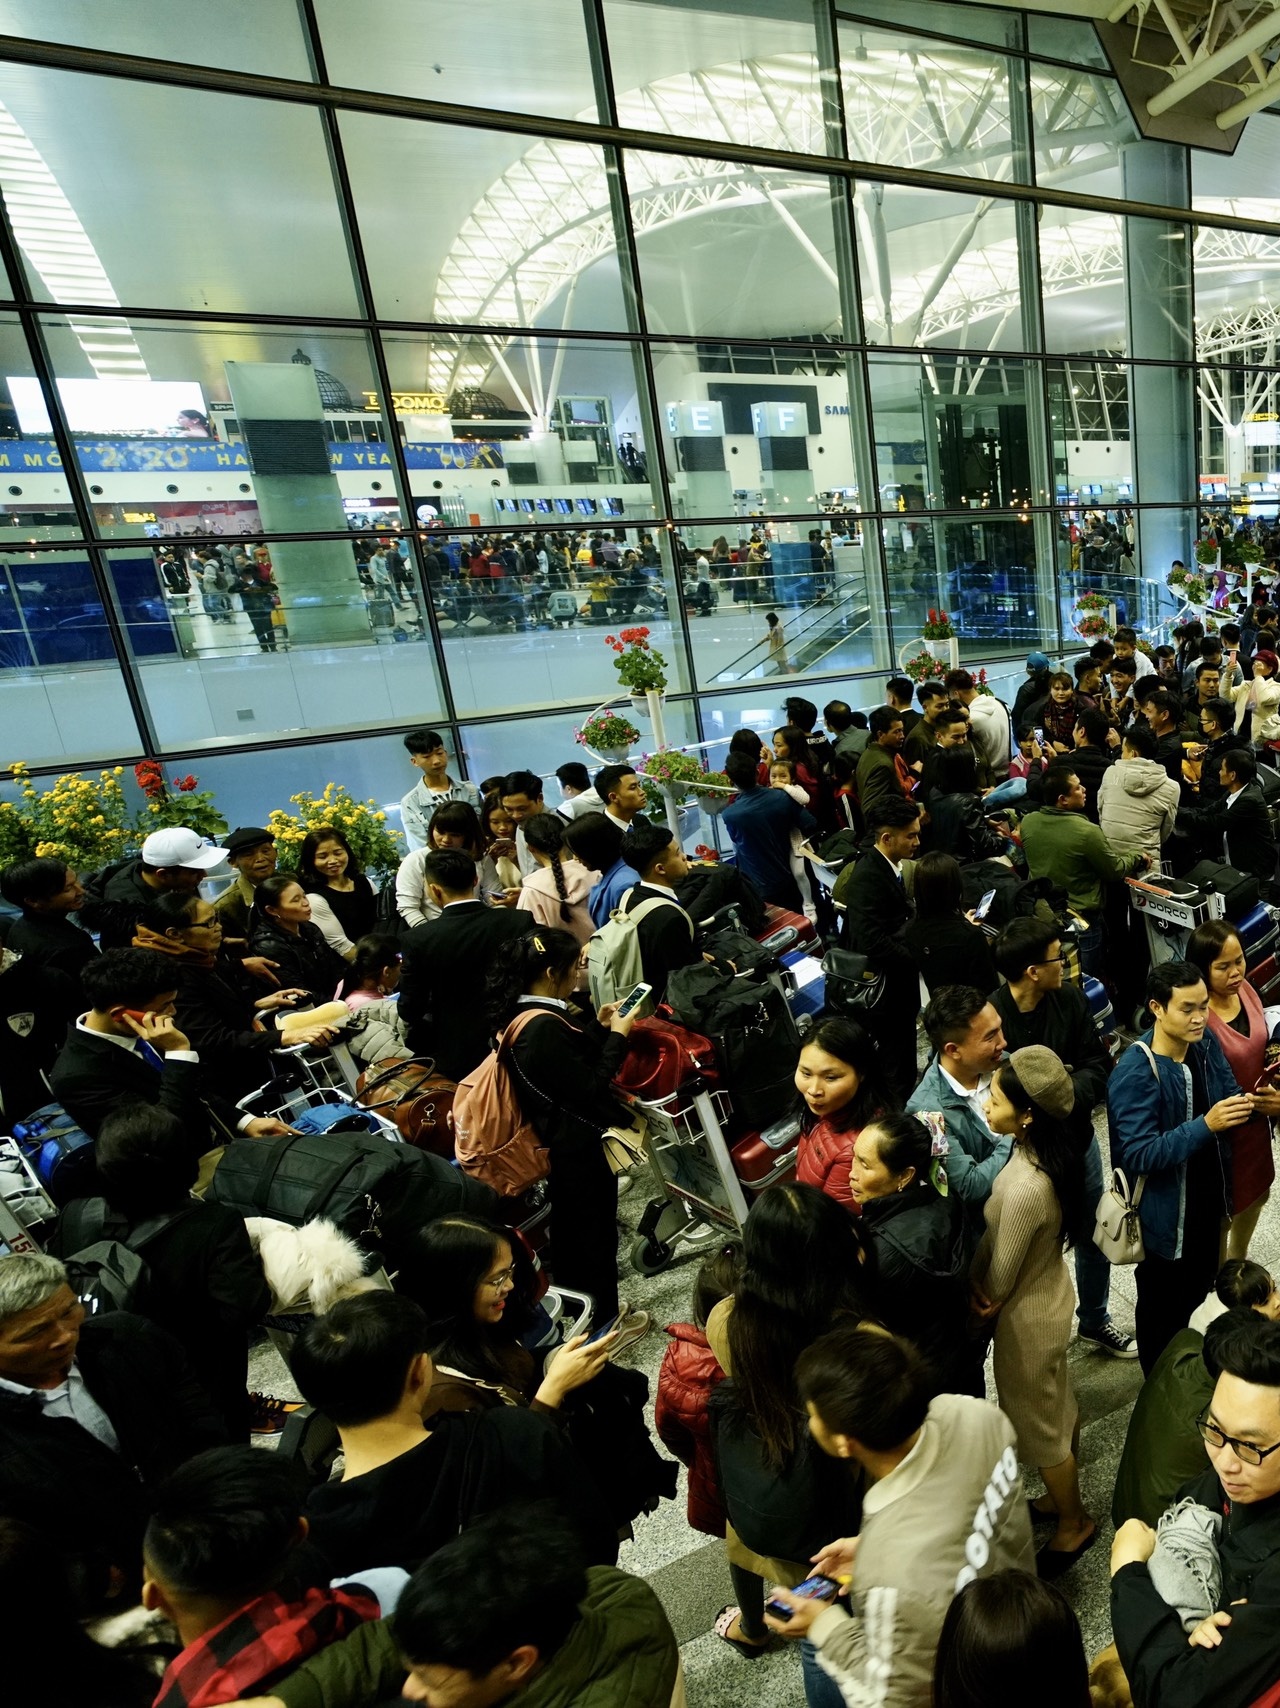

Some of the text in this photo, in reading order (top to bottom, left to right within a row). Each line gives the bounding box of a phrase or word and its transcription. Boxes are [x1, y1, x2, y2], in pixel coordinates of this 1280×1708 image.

[691, 407, 712, 431] E
[778, 407, 795, 431] F
[825, 405, 849, 416] SAM
[354, 453, 391, 464] YEA
[1149, 901, 1188, 920] DORCO
[9, 1233, 38, 1253] 15
